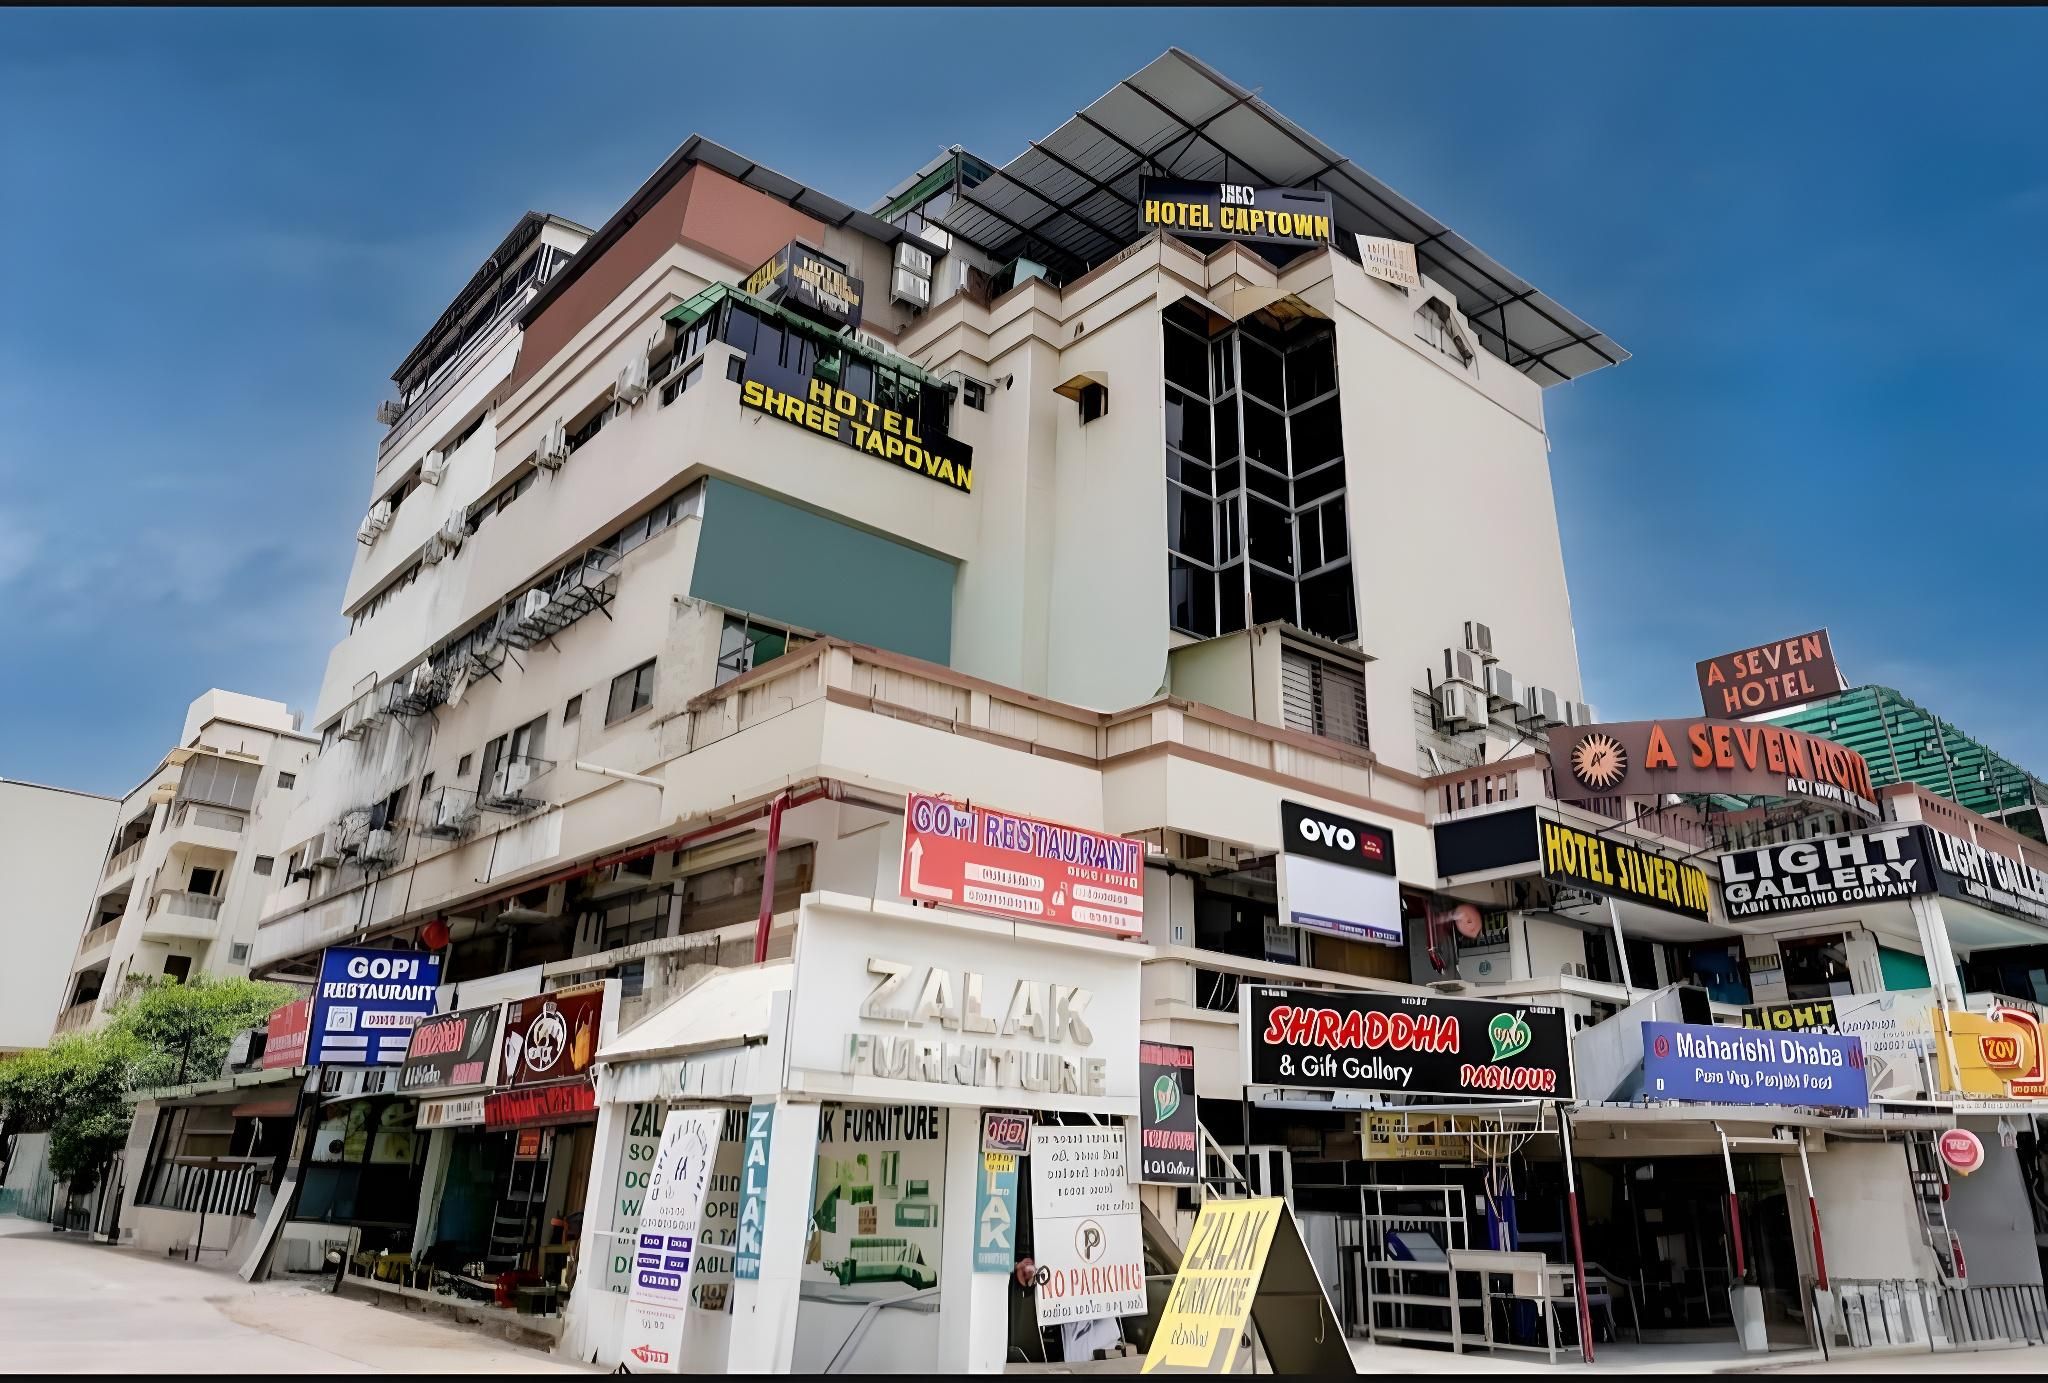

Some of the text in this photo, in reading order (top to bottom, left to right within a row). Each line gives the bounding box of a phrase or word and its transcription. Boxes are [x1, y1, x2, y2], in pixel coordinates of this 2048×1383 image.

[1145, 200, 1213, 229] HOTEL
[809, 378, 922, 443] HOTEL
[743, 380, 972, 491] SHREE TAPOVAN
[1707, 635, 1823, 686] A SEVEN
[1722, 669, 1815, 713] HOTEL
[1645, 722, 1678, 769] A
[1688, 722, 1809, 780] SEVEN
[1300, 817, 1356, 851] OYO
[1720, 827, 1910, 885] LIGHT
[1545, 823, 1614, 886] HOTEL
[1616, 847, 1680, 907] SILVER
[1724, 858, 1918, 903] GALLERY
[347, 956, 420, 980] GOPI
[859, 957, 1094, 1046] ZALAK
[1263, 1005, 1460, 1055] SHRADDHA
[1280, 1054, 1295, 1076] &
[1301, 1053, 1338, 1078] Gift
[1780, 1039, 1843, 1067] Dhaba
[843, 1105, 939, 1143] FURNITURE
[1041, 1262, 1142, 1300] NO PARKING
